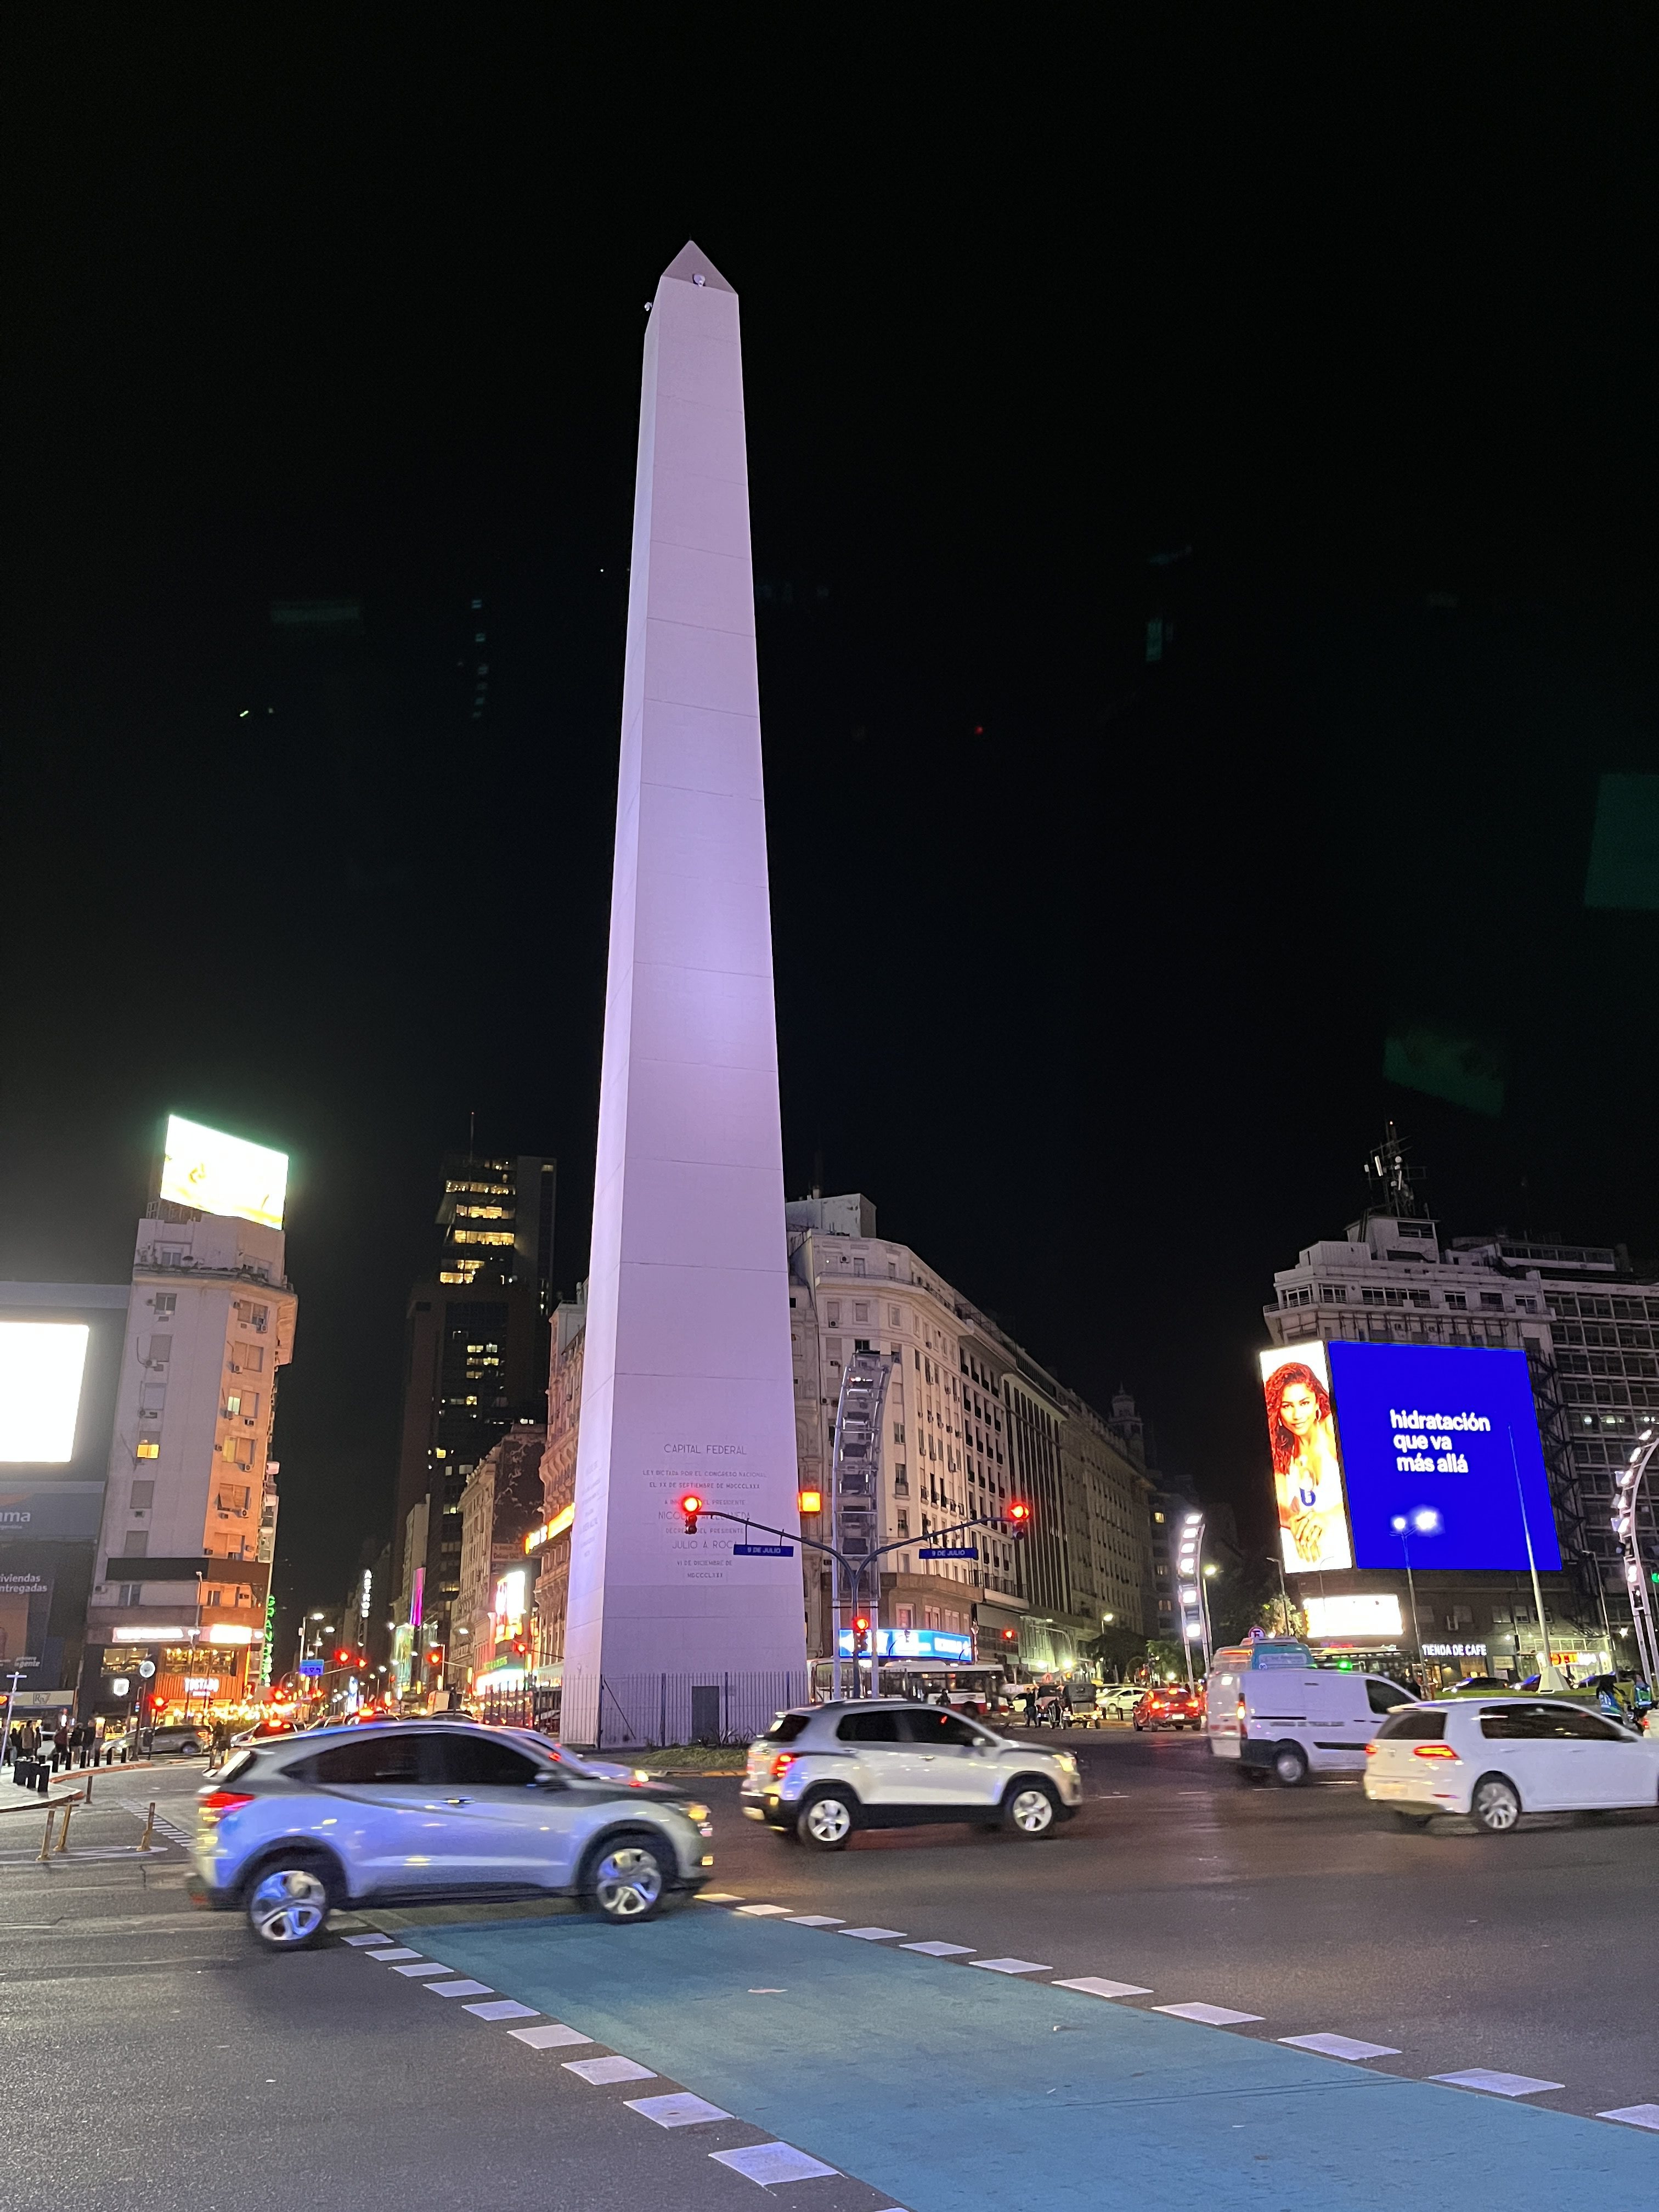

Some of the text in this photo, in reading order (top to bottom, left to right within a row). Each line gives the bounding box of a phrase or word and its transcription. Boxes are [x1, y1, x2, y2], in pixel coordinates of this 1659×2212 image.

[1390, 1409, 1491, 1431] hidratación
[664, 1444, 747, 1454] CAPITAL FEDERAL
[1393, 1434, 1452, 1453] que va
[1397, 1452, 1469, 1473] más allá
[672, 1541, 698, 1549] JULIO
[703, 1540, 708, 1549] A
[1421, 1644, 1487, 1656] TIENDA DE CAFE
